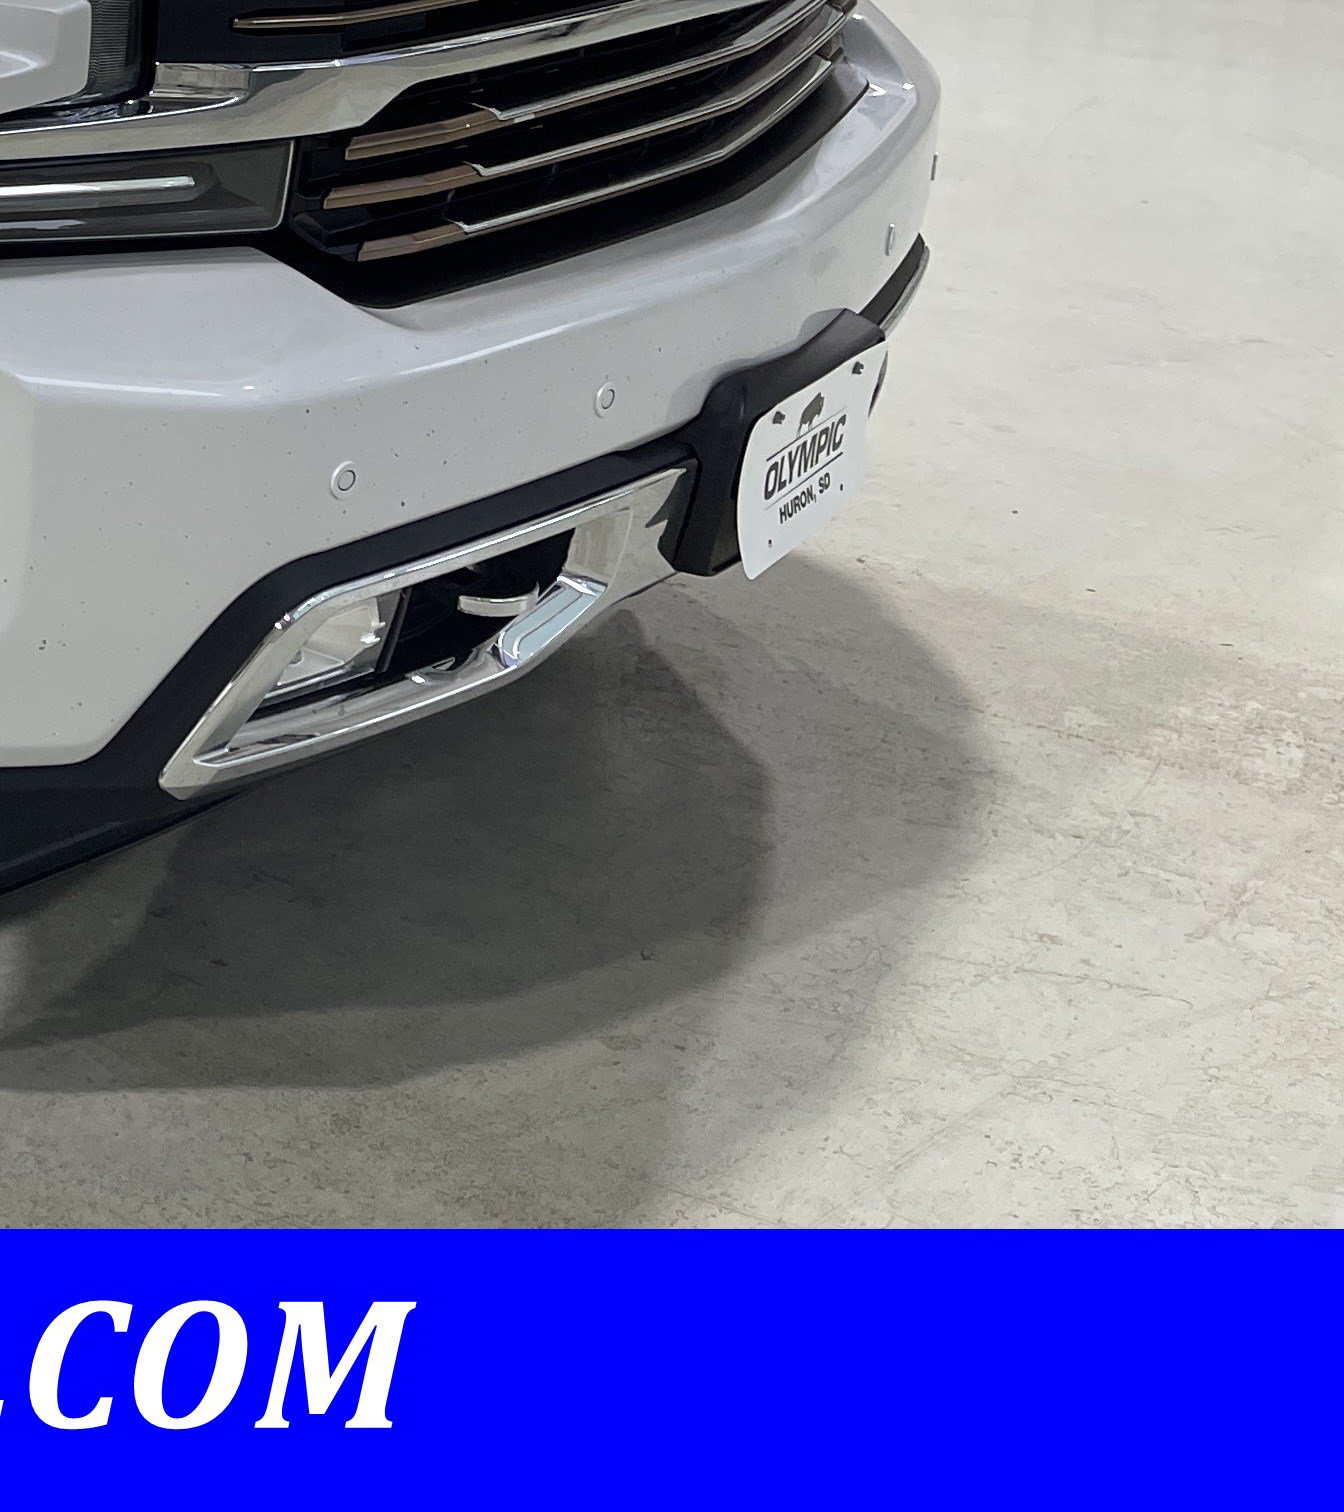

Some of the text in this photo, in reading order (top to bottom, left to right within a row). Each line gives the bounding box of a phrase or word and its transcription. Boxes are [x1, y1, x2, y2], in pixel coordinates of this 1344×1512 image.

[764, 414, 847, 501] OLYMPIC
[779, 472, 831, 524] HURON, SD
